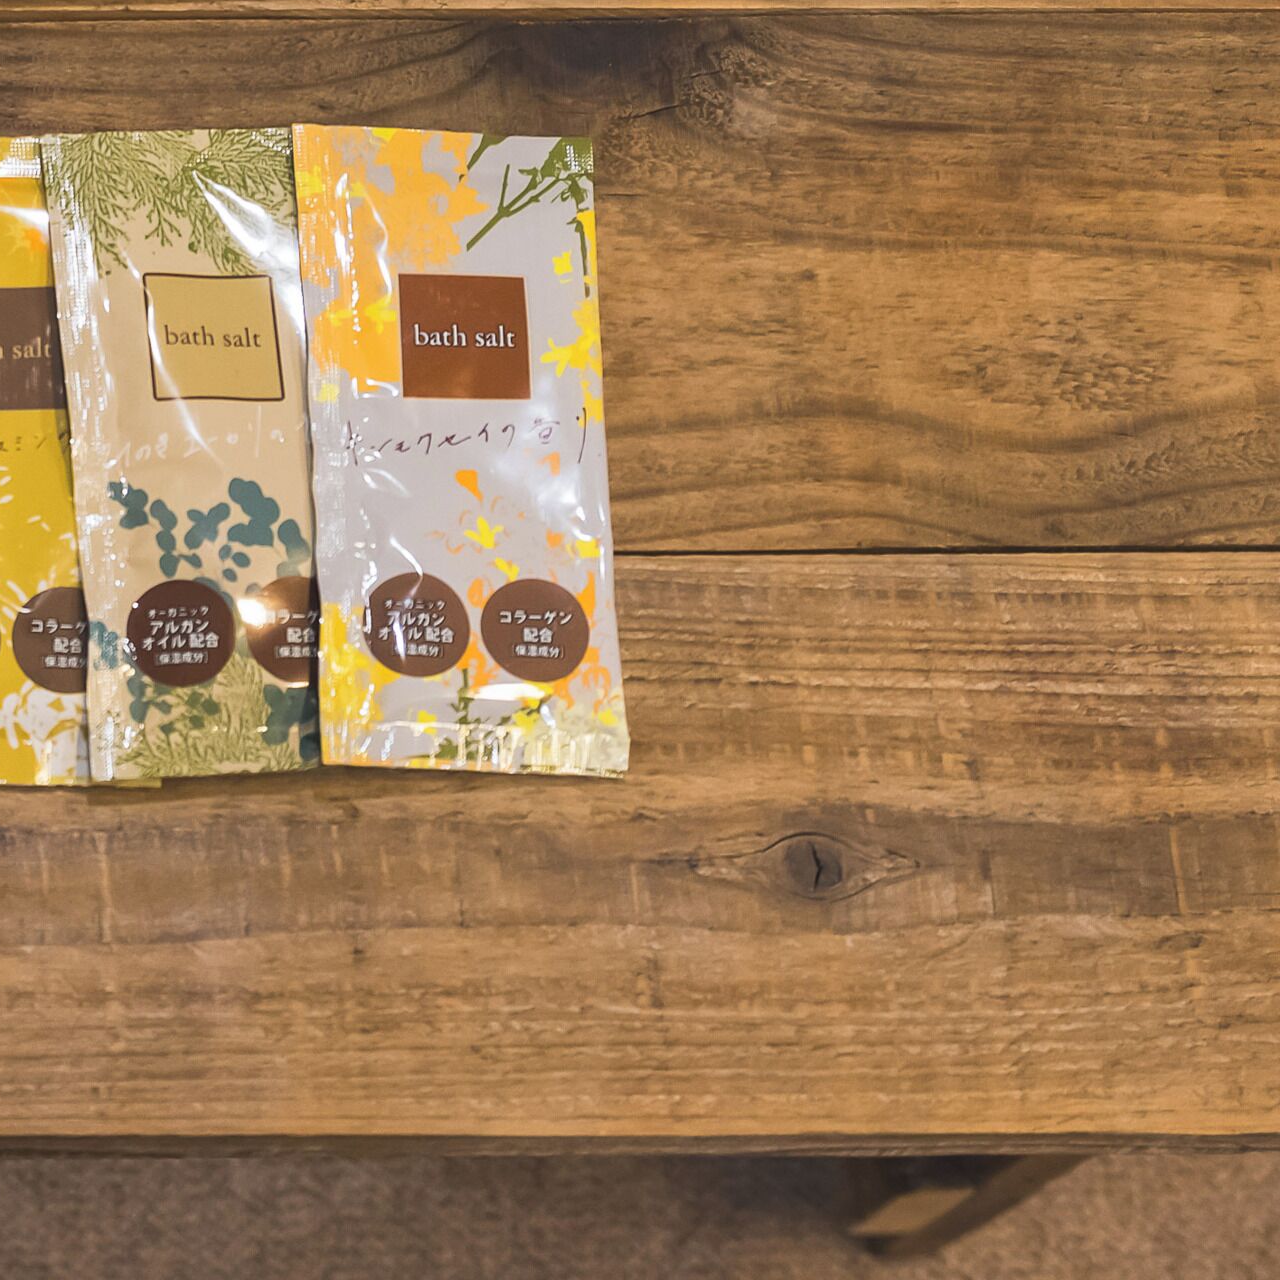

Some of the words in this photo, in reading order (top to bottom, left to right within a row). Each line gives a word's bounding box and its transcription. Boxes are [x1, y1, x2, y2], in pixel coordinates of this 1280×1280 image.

[163, 324, 215, 347] bath
[223, 325, 262, 348] salt
[414, 323, 467, 347] bath
[475, 324, 515, 348] salt
[12, 336, 52, 360] salt
[148, 605, 210, 619] オーガニック
[499, 609, 574, 625] コラーゲン
[149, 620, 210, 636] アルガン
[522, 627, 554, 644] 配合
[52, 636, 83, 654] 配合
